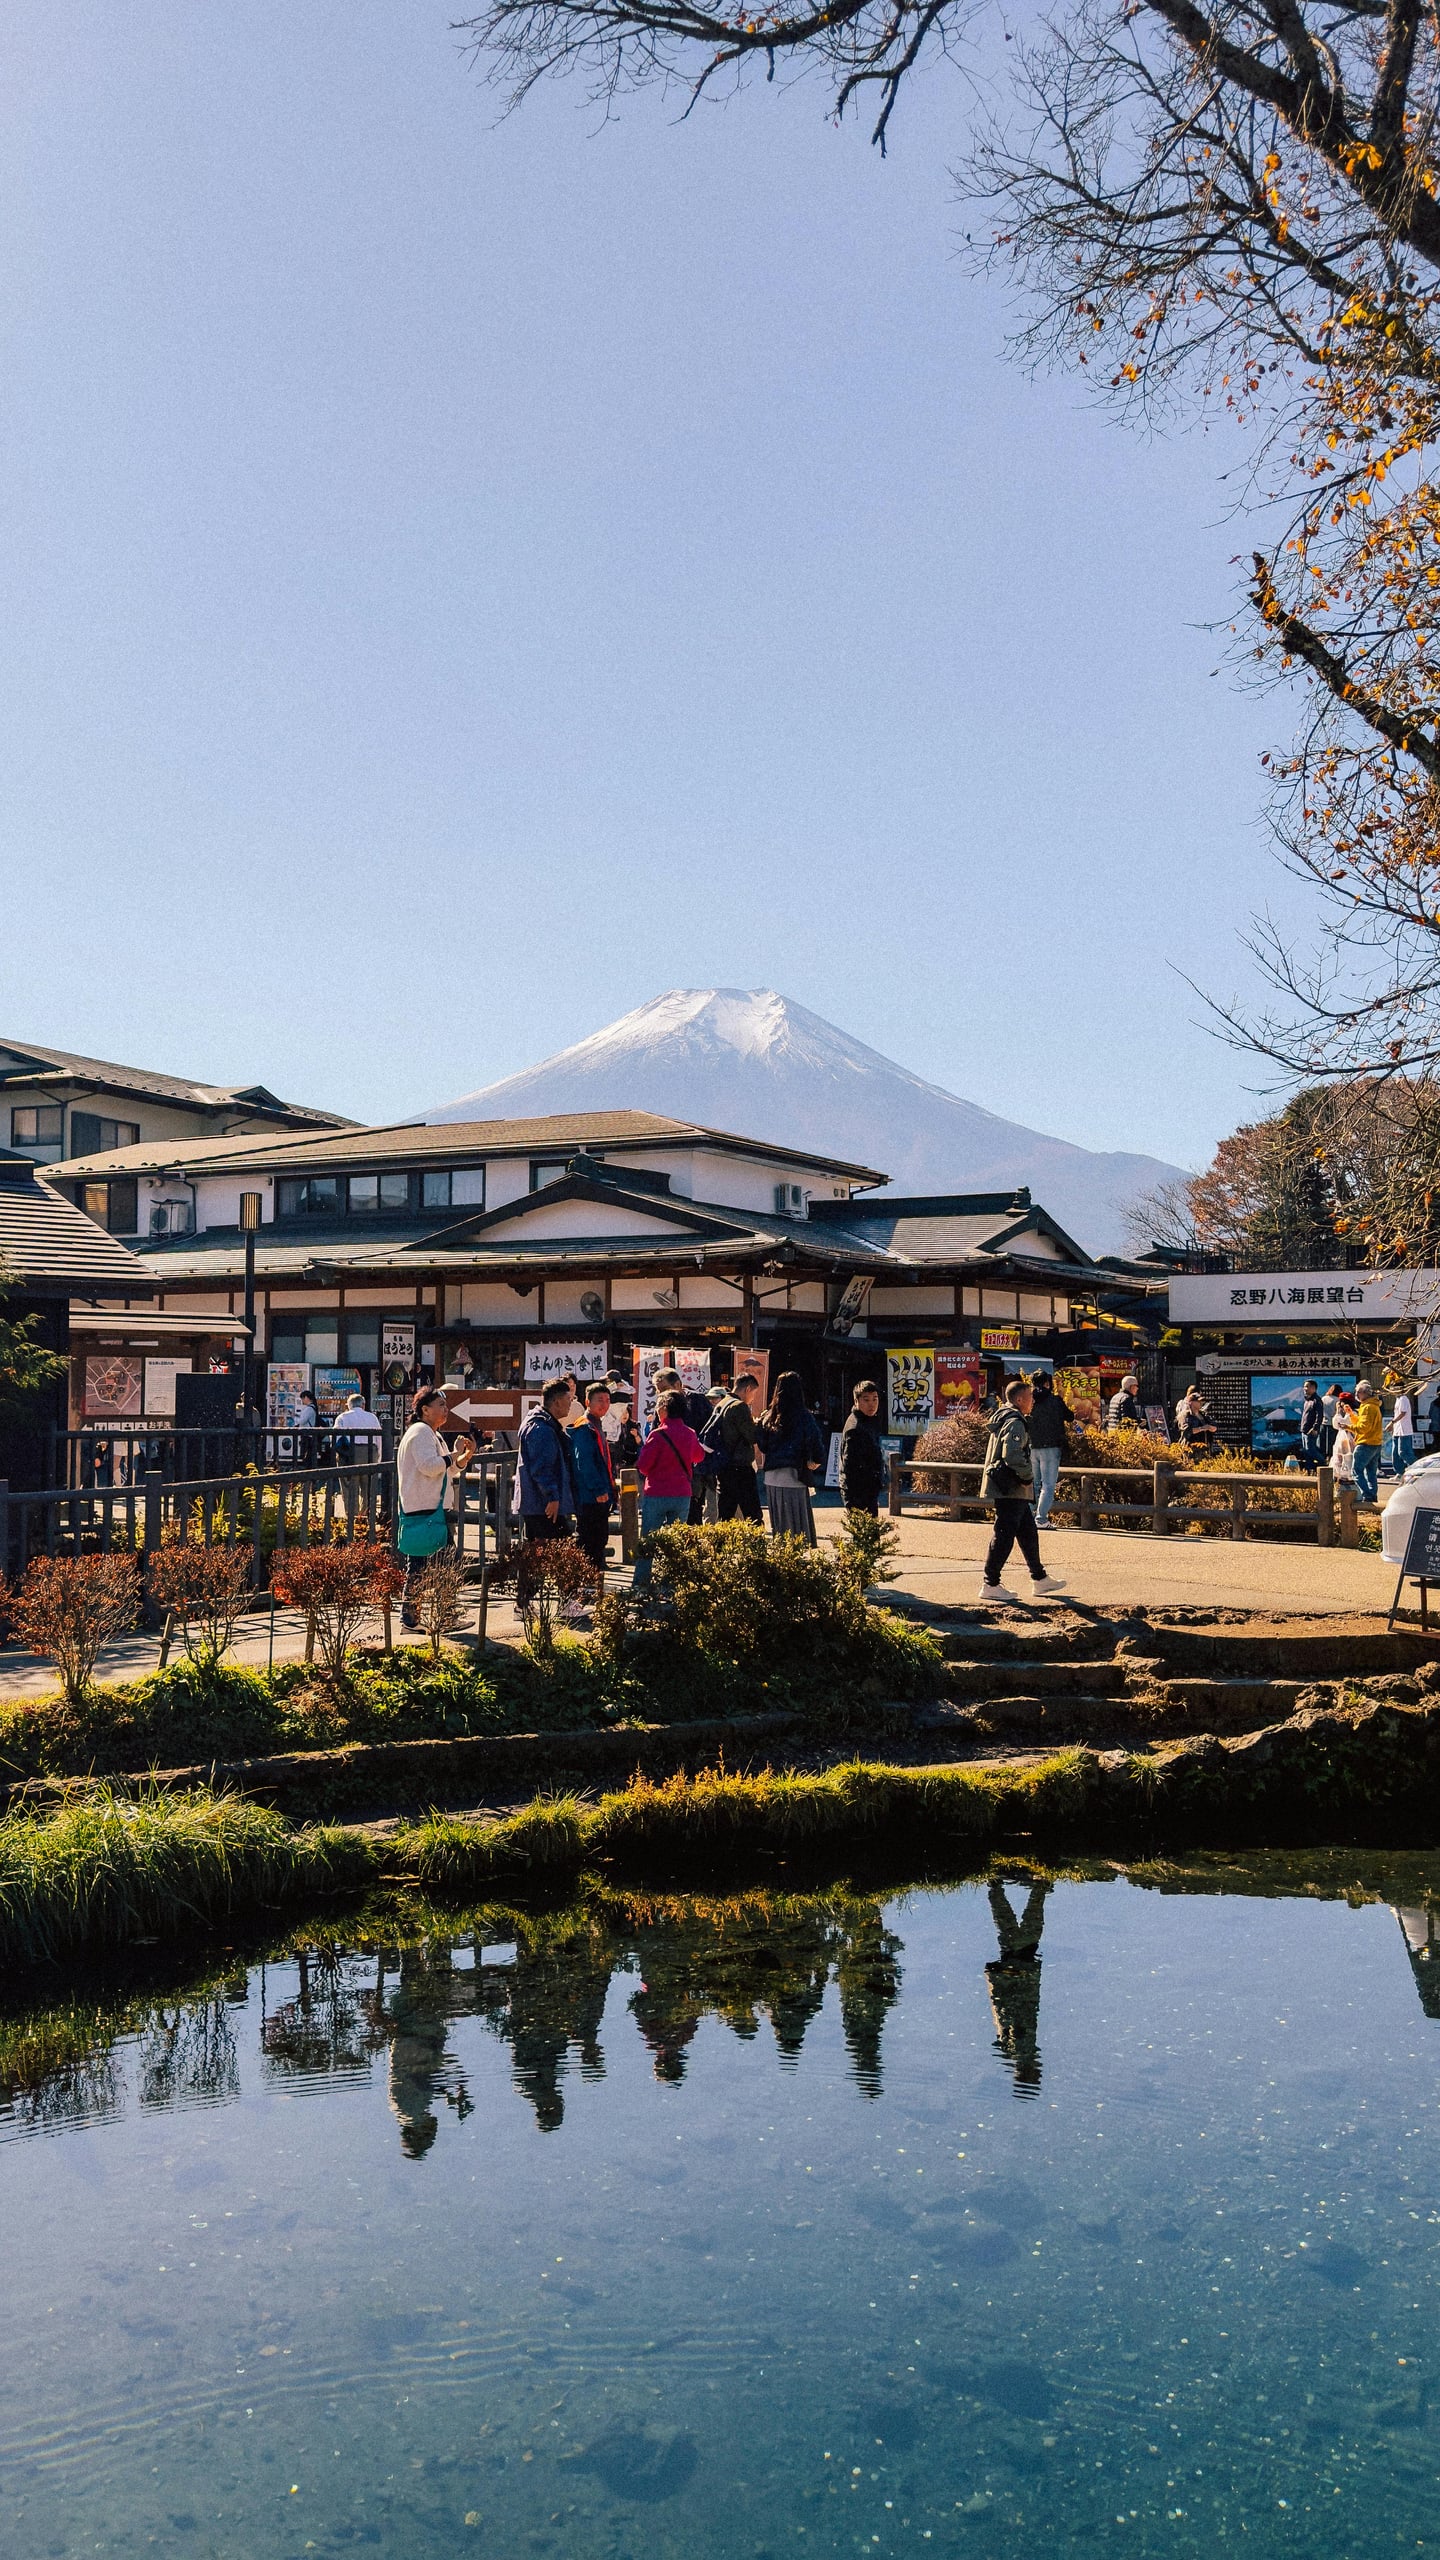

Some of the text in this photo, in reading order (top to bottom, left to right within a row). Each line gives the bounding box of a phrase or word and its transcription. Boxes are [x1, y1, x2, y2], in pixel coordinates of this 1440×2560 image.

[1230, 1286, 1364, 1306] 忍野八海展望台
[384, 1342, 413, 1355] ほうとう
[529, 1354, 604, 1372] はんのき食堂
[892, 1397, 933, 1414] バナナ
